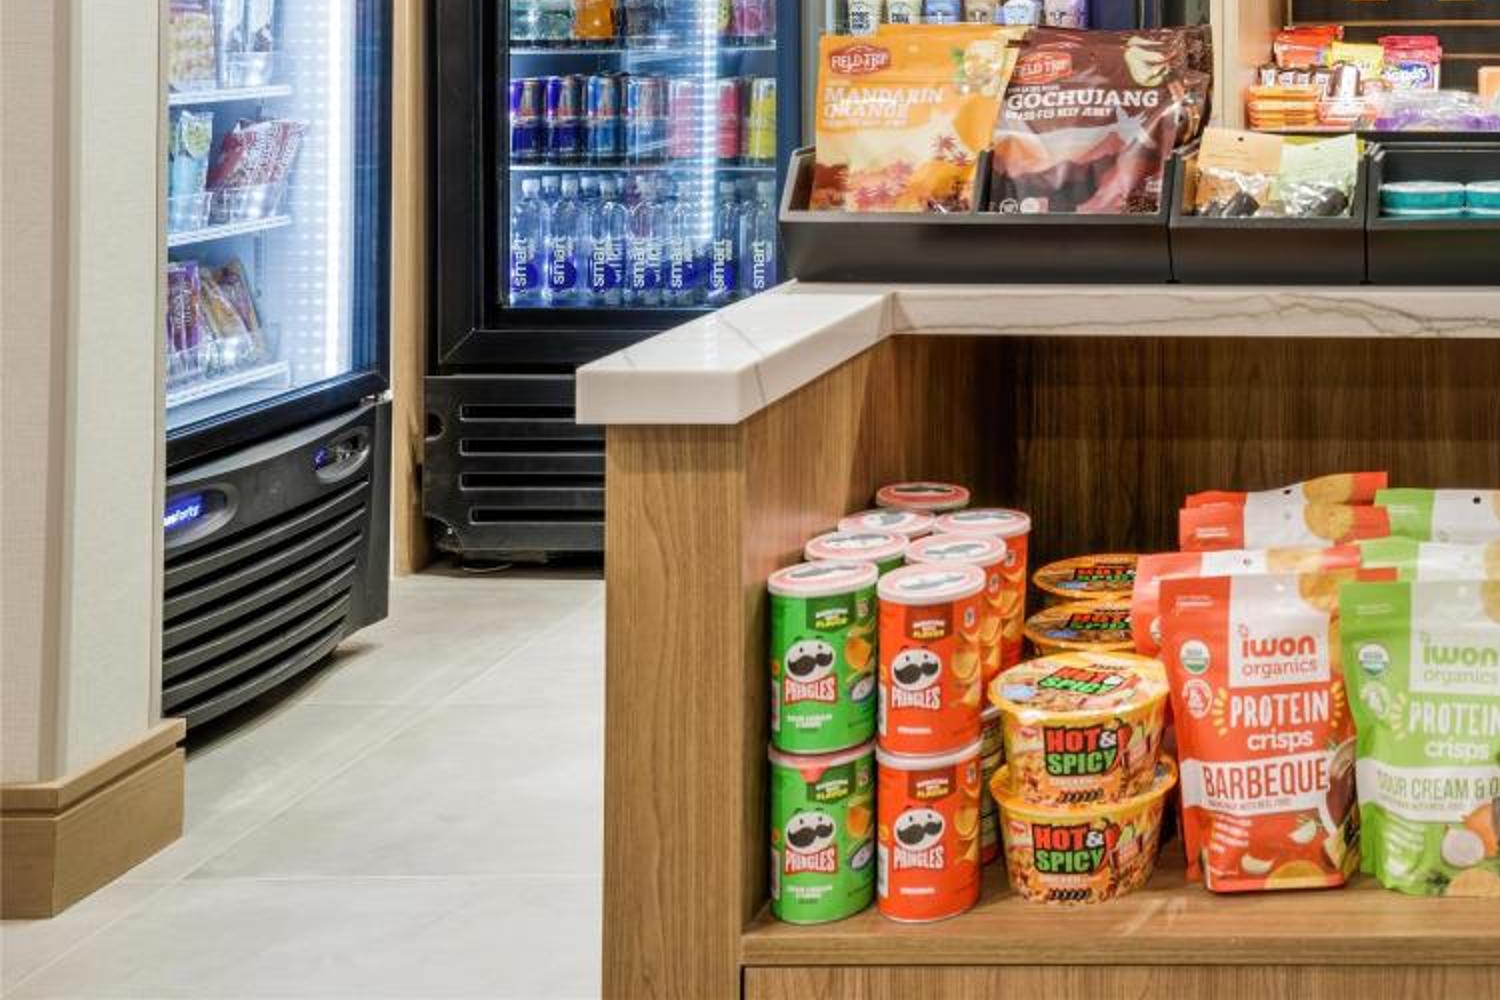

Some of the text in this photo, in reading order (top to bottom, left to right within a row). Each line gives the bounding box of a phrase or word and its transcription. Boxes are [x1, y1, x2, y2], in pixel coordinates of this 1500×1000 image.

[1007, 88, 1160, 111] GOCHUJANG
[1242, 633, 1316, 658] iwon
[1423, 645, 1499, 665] iwon
[1241, 657, 1317, 679] organics
[785, 677, 836, 703] PRINGLES
[1229, 690, 1330, 728] PROTEIN
[1046, 725, 1101, 752] HOT
[1247, 728, 1313, 751] crisps
[1424, 736, 1489, 762] crisps
[1047, 749, 1117, 775] SPICY
[1203, 757, 1330, 800] BARBEQUE
[1411, 777, 1470, 800] CREAM
[1034, 826, 1088, 849] HOT
[785, 849, 836, 872] PRINGLES
[893, 846, 944, 870] PRINGLES
[1034, 849, 1105, 873] SPICY
